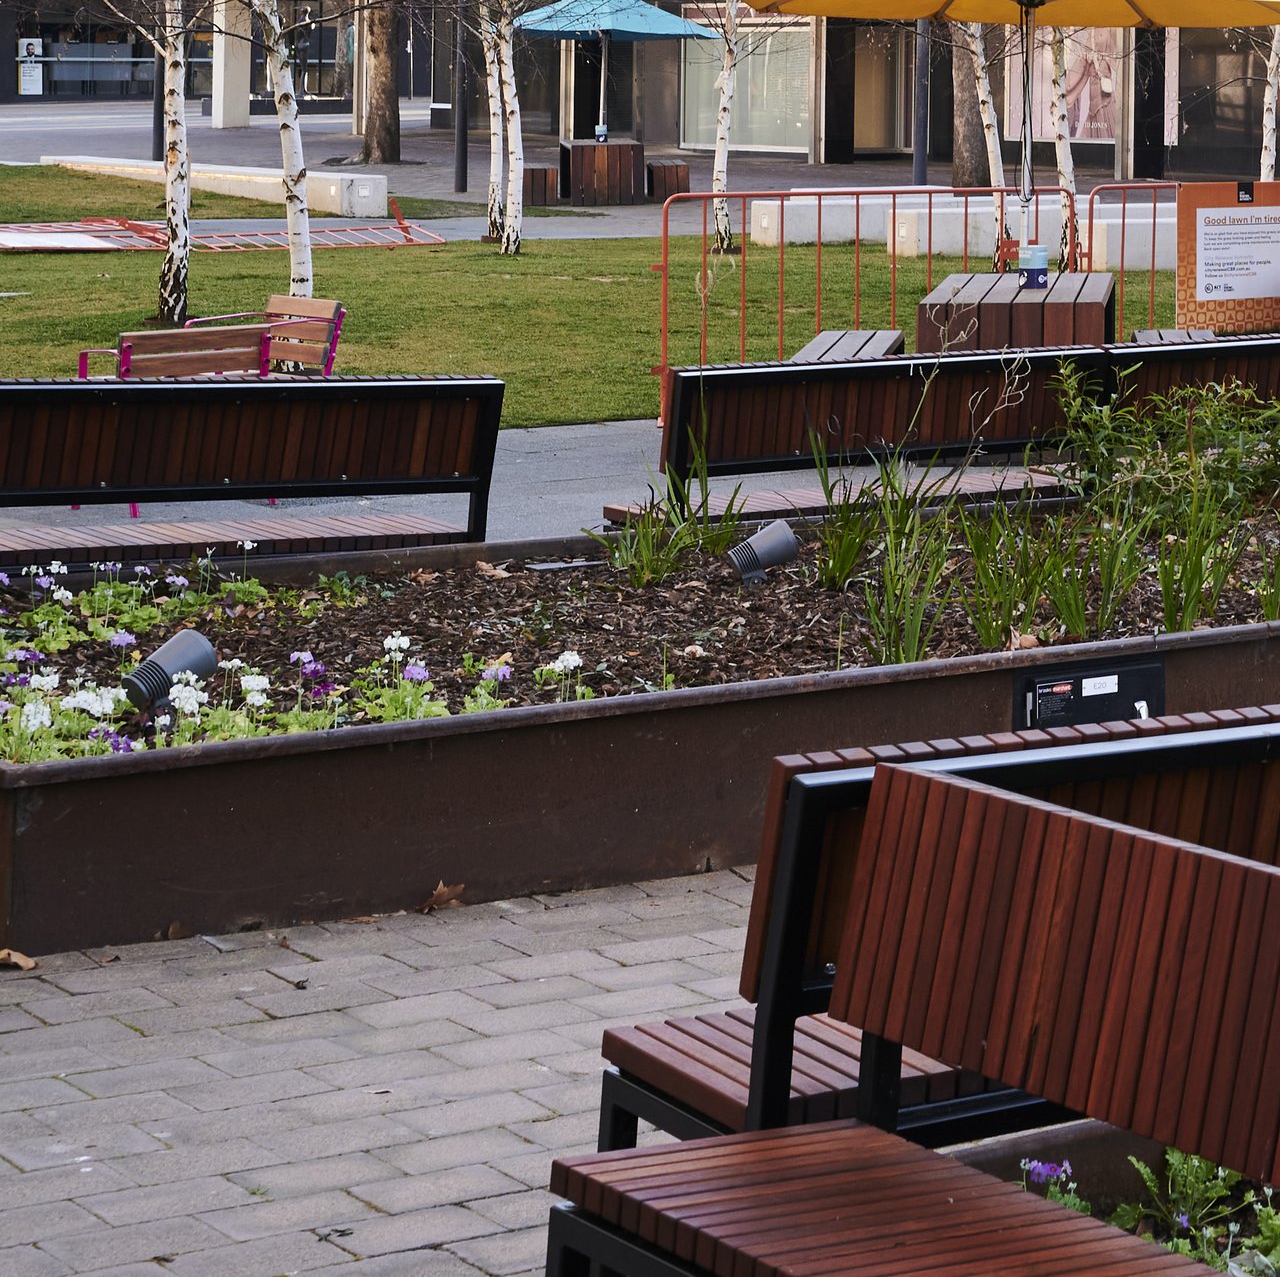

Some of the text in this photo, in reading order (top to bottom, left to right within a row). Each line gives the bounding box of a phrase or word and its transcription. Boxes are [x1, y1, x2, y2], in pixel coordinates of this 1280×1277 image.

[1204, 216, 1227, 225] Good
[1229, 215, 1249, 224] lawn
[1250, 215, 1262, 223] I'm
[1093, 681, 1107, 690] E20
